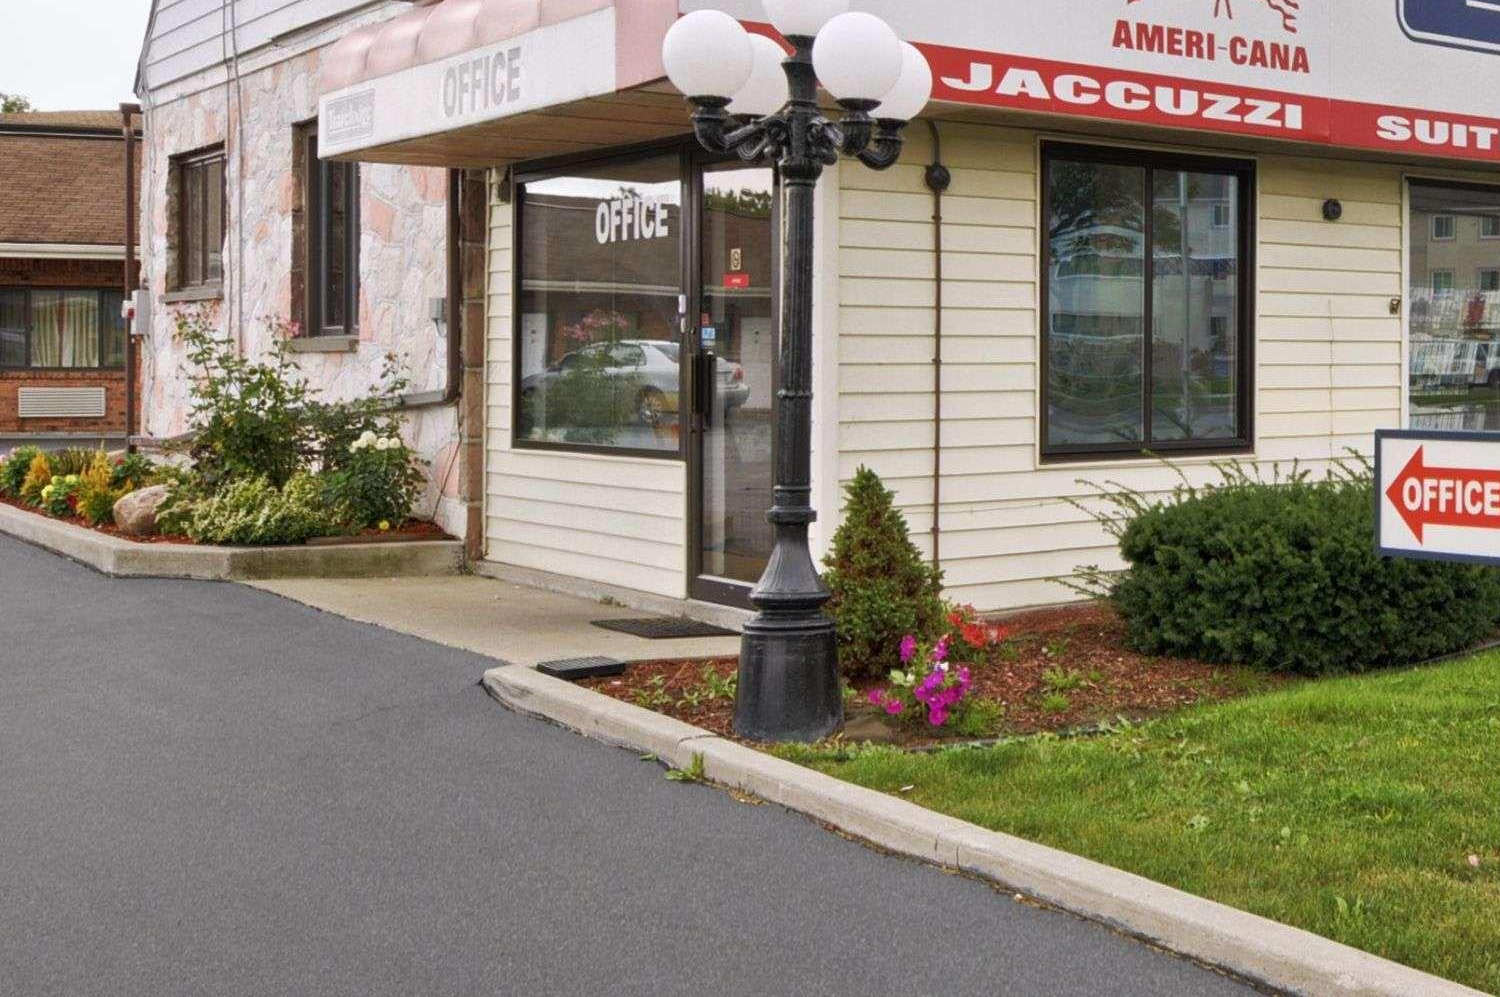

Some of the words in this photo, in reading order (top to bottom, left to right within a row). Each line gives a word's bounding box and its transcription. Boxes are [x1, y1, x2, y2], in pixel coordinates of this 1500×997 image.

[1112, 19, 1310, 74] AMERI-CANA
[443, 47, 521, 118] OFFICE
[940, 62, 1303, 130] JACCUZZI
[596, 197, 669, 244] OFFICE
[1402, 477, 1500, 516] OFFICE
